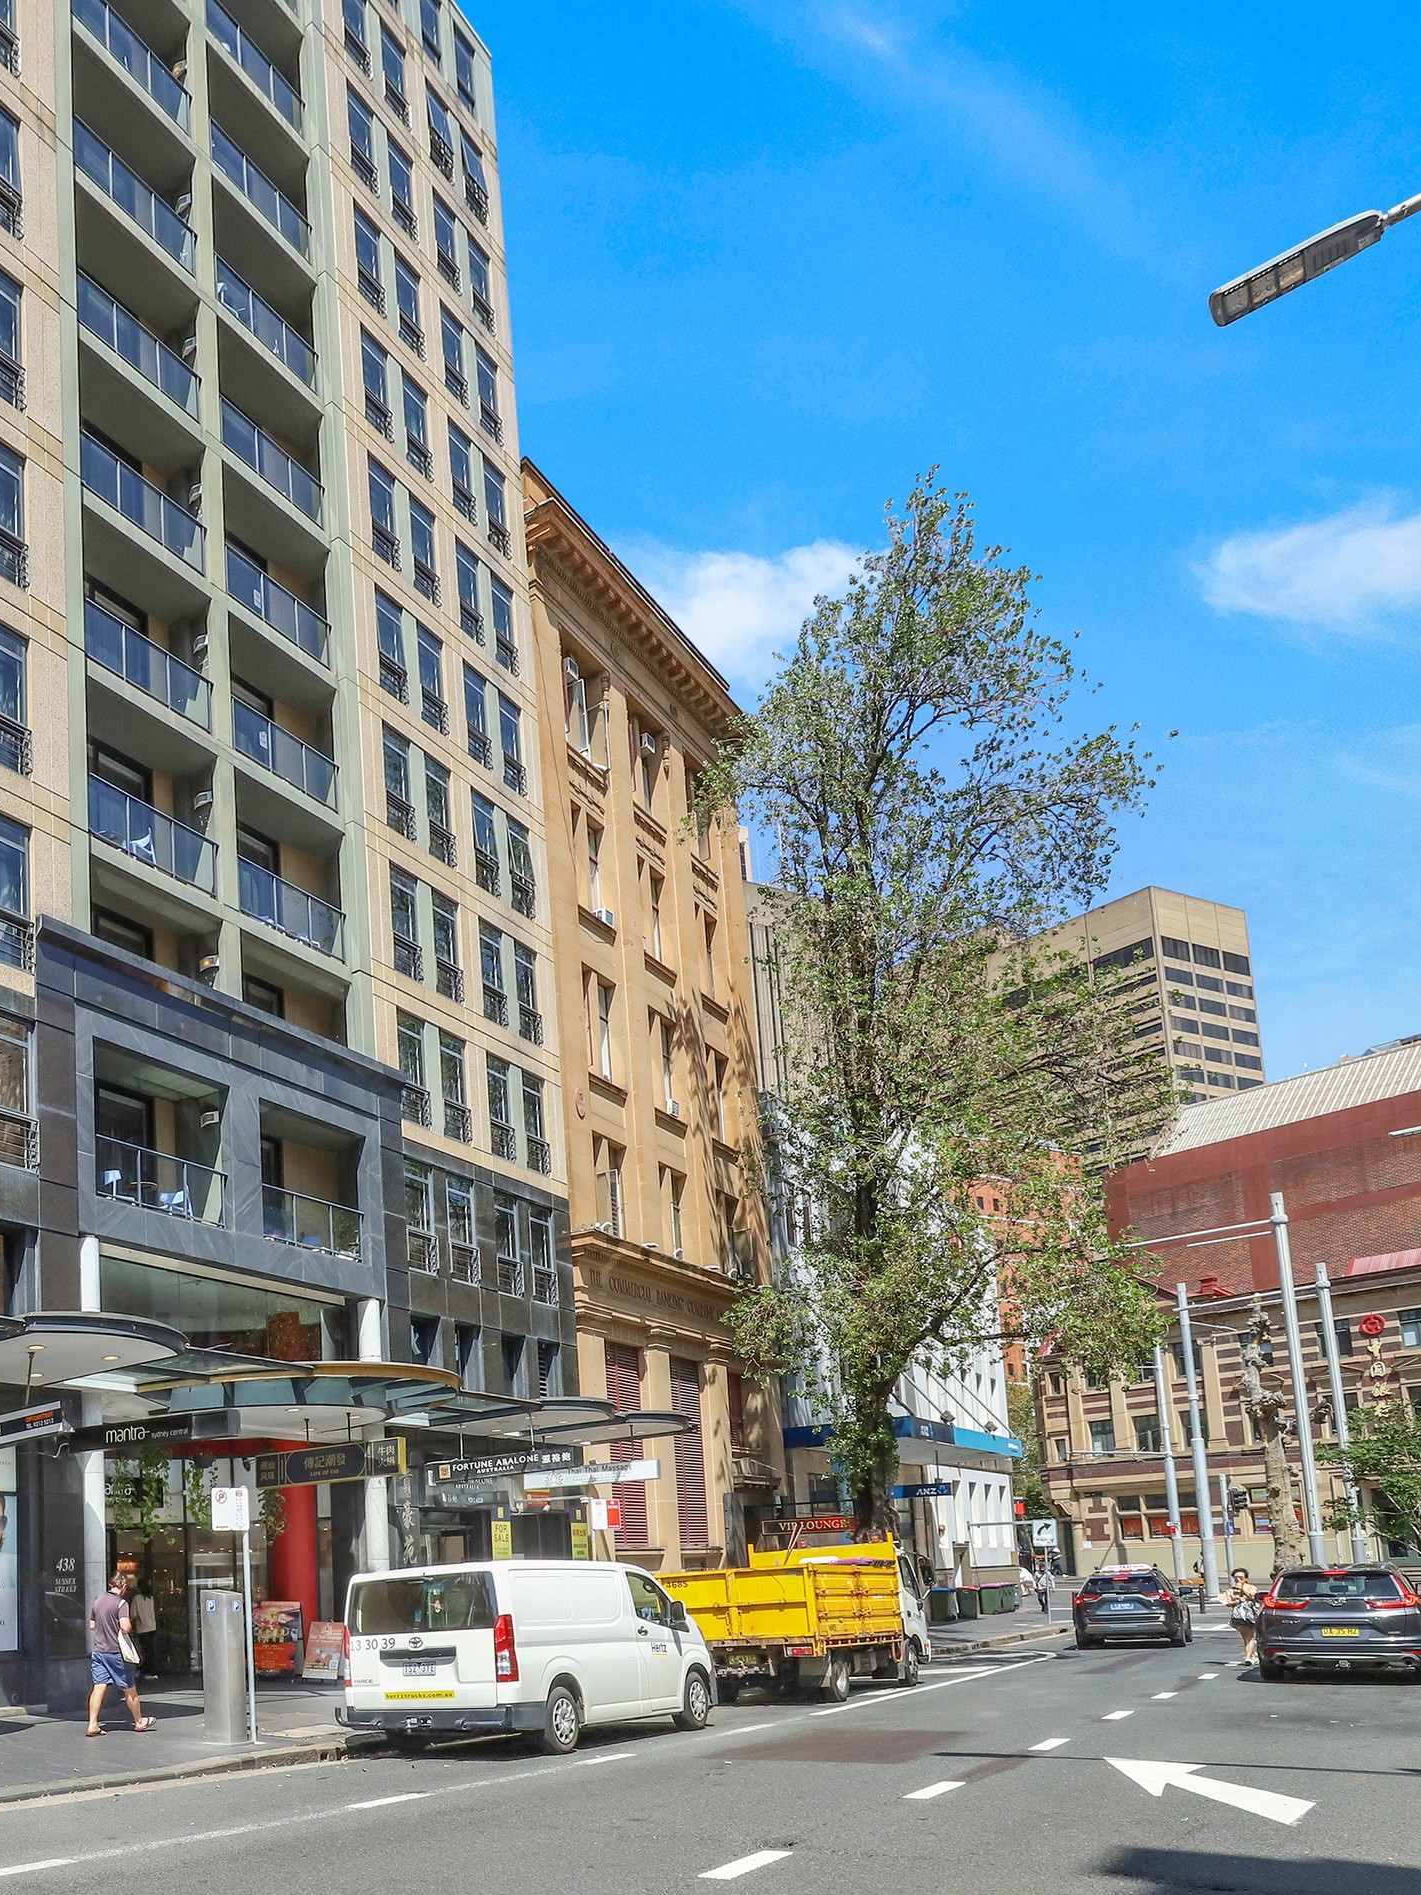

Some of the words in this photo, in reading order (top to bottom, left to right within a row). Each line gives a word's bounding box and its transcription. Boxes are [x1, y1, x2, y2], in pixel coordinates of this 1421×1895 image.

[589, 1268, 603, 1289] THE
[105, 1426, 150, 1444] mantra
[151, 1431, 170, 1440] sydney
[170, 1427, 189, 1437] central
[452, 1459, 493, 1472] FORTUNE
[496, 1454, 539, 1467] ABALONE
[476, 1465, 515, 1475] AUSTRALIA
[915, 1487, 937, 1496] ANZ
[494, 1524, 508, 1533] FOR
[494, 1533, 510, 1543] SALE
[55, 1557, 76, 1572] 438
[55, 1585, 78, 1593] STREET
[665, 1580, 689, 1589] 4685
[351, 1639, 362, 1651] 13
[365, 1639, 379, 1650] 30
[381, 1637, 396, 1650] 39
[650, 1642, 667, 1653] Hertz
[385, 1692, 453, 1700] hertztrucks.com.au
